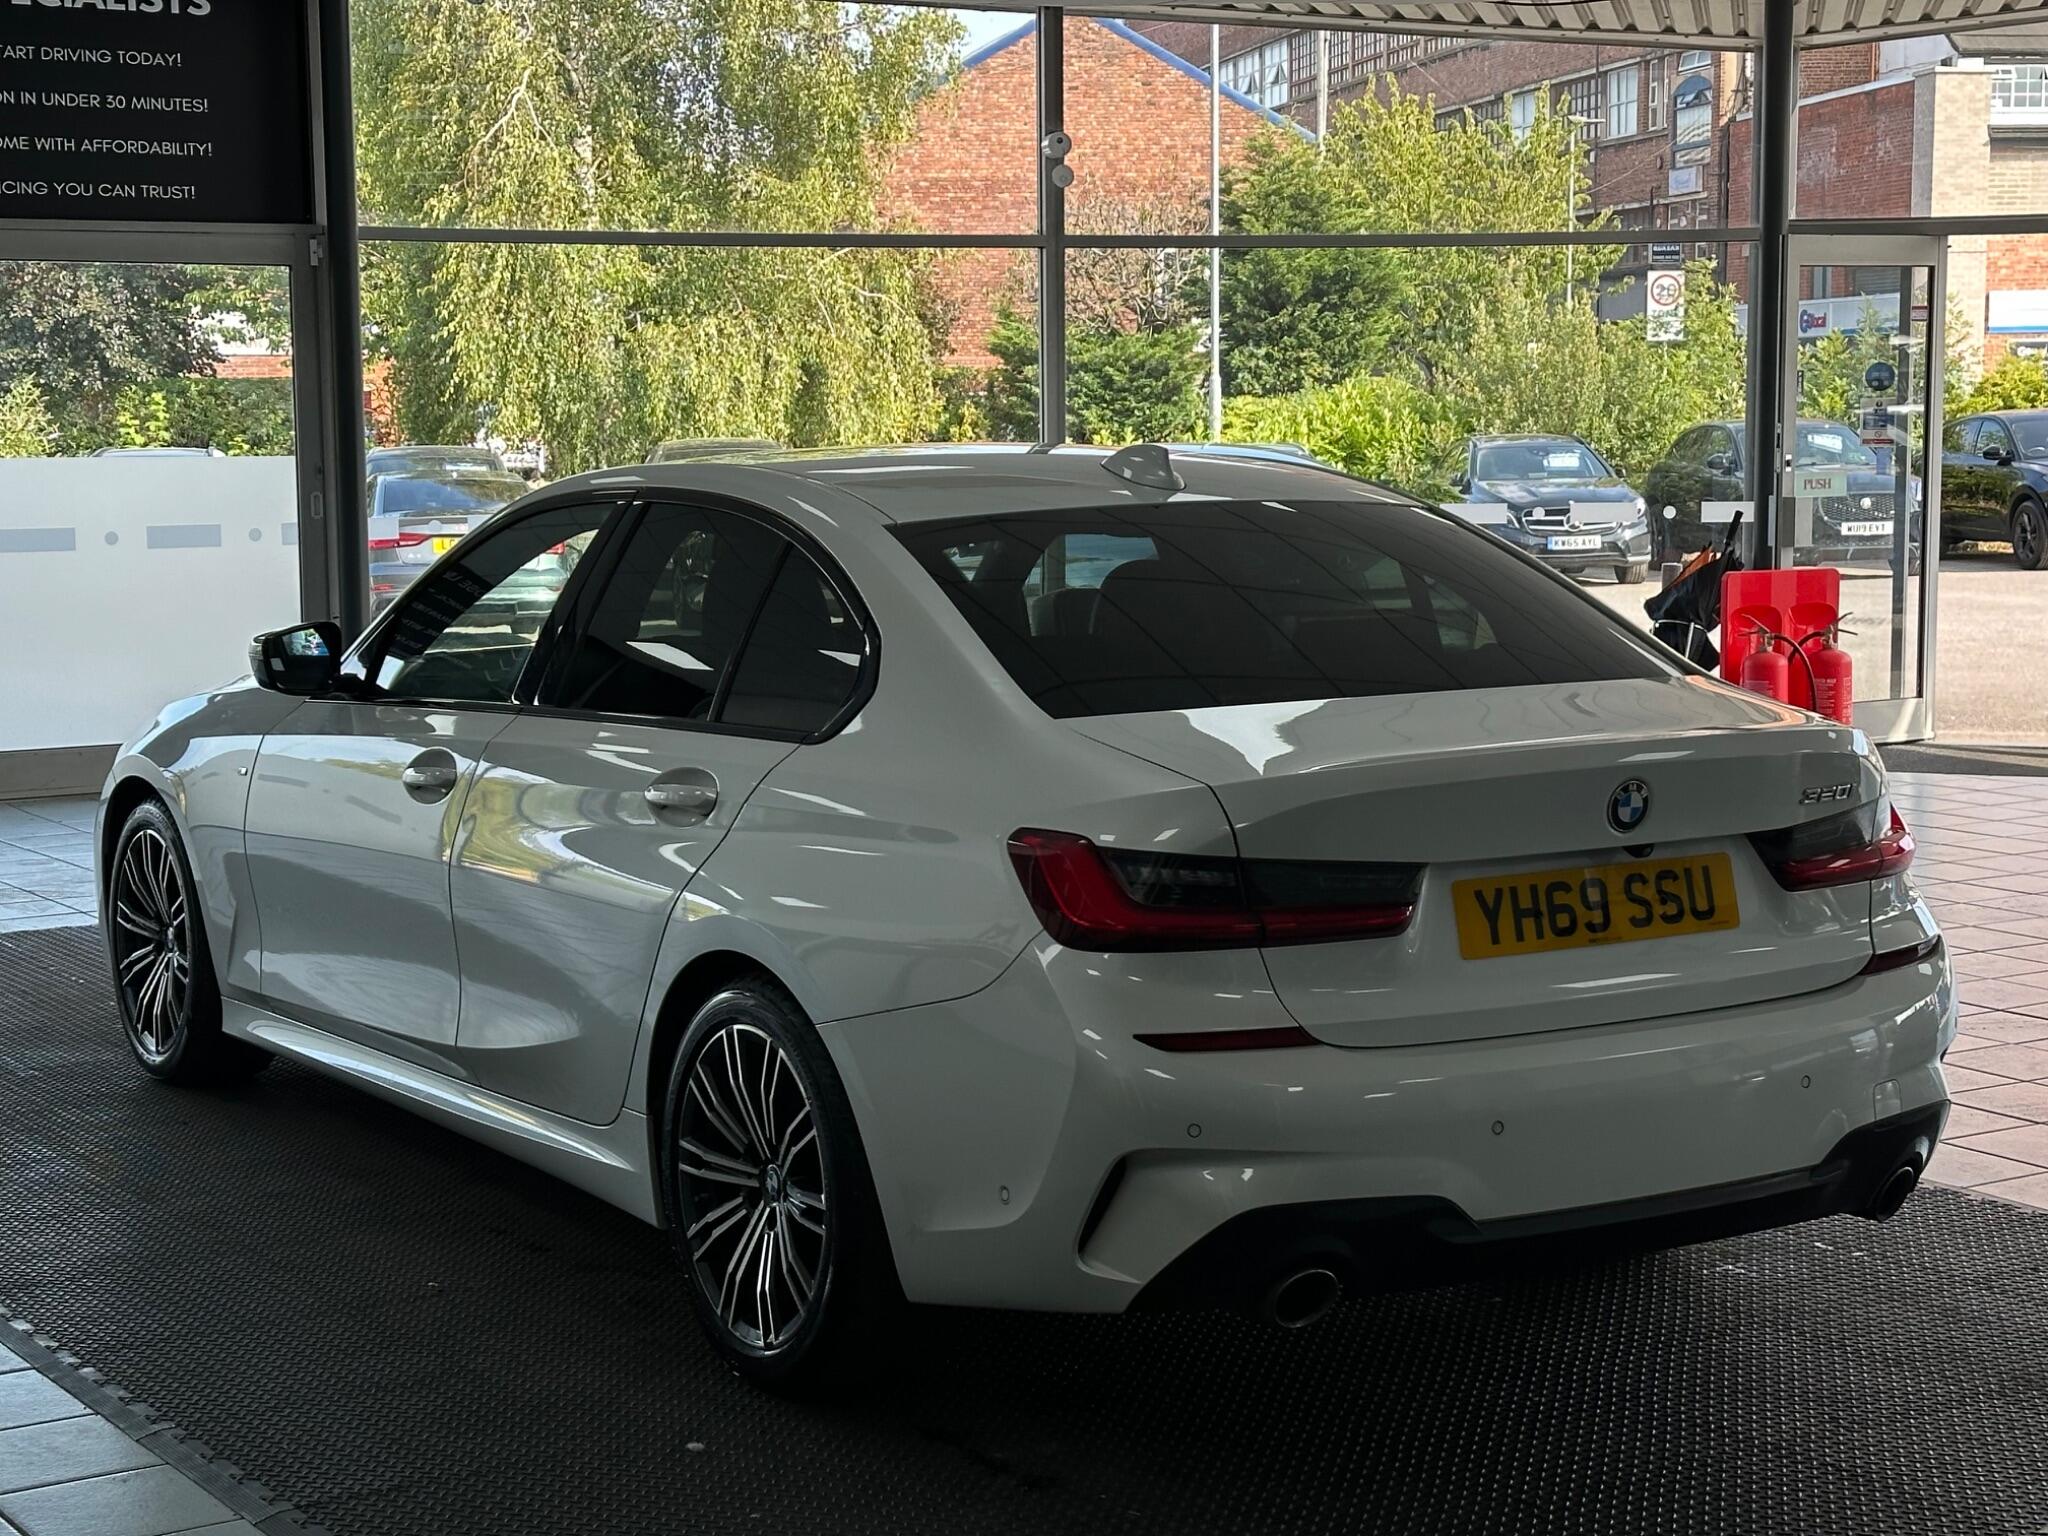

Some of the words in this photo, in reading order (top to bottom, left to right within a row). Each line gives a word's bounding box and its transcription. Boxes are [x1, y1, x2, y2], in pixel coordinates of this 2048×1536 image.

[0, 45, 35, 60] ART
[41, 47, 112, 64] DRIVING
[117, 51, 182, 67] TODAY!
[0, 91, 14, 105] N
[21, 91, 36, 105] IN
[42, 92, 100, 108] UNDER
[106, 95, 126, 109] 30
[131, 97, 208, 113] MINUTES!
[0, 136, 30, 150] ME
[35, 137, 75, 152] WITH
[81, 138, 212, 157] AFFORDABILITY!
[0, 181, 48, 195] CING
[53, 183, 93, 197] YOU
[98, 184, 135, 198] CAN
[140, 185, 195, 199] TRUST!
[1803, 478, 1832, 490] PUSH
[1474, 878, 1612, 945] YH69
[1624, 865, 1716, 929] SSU
